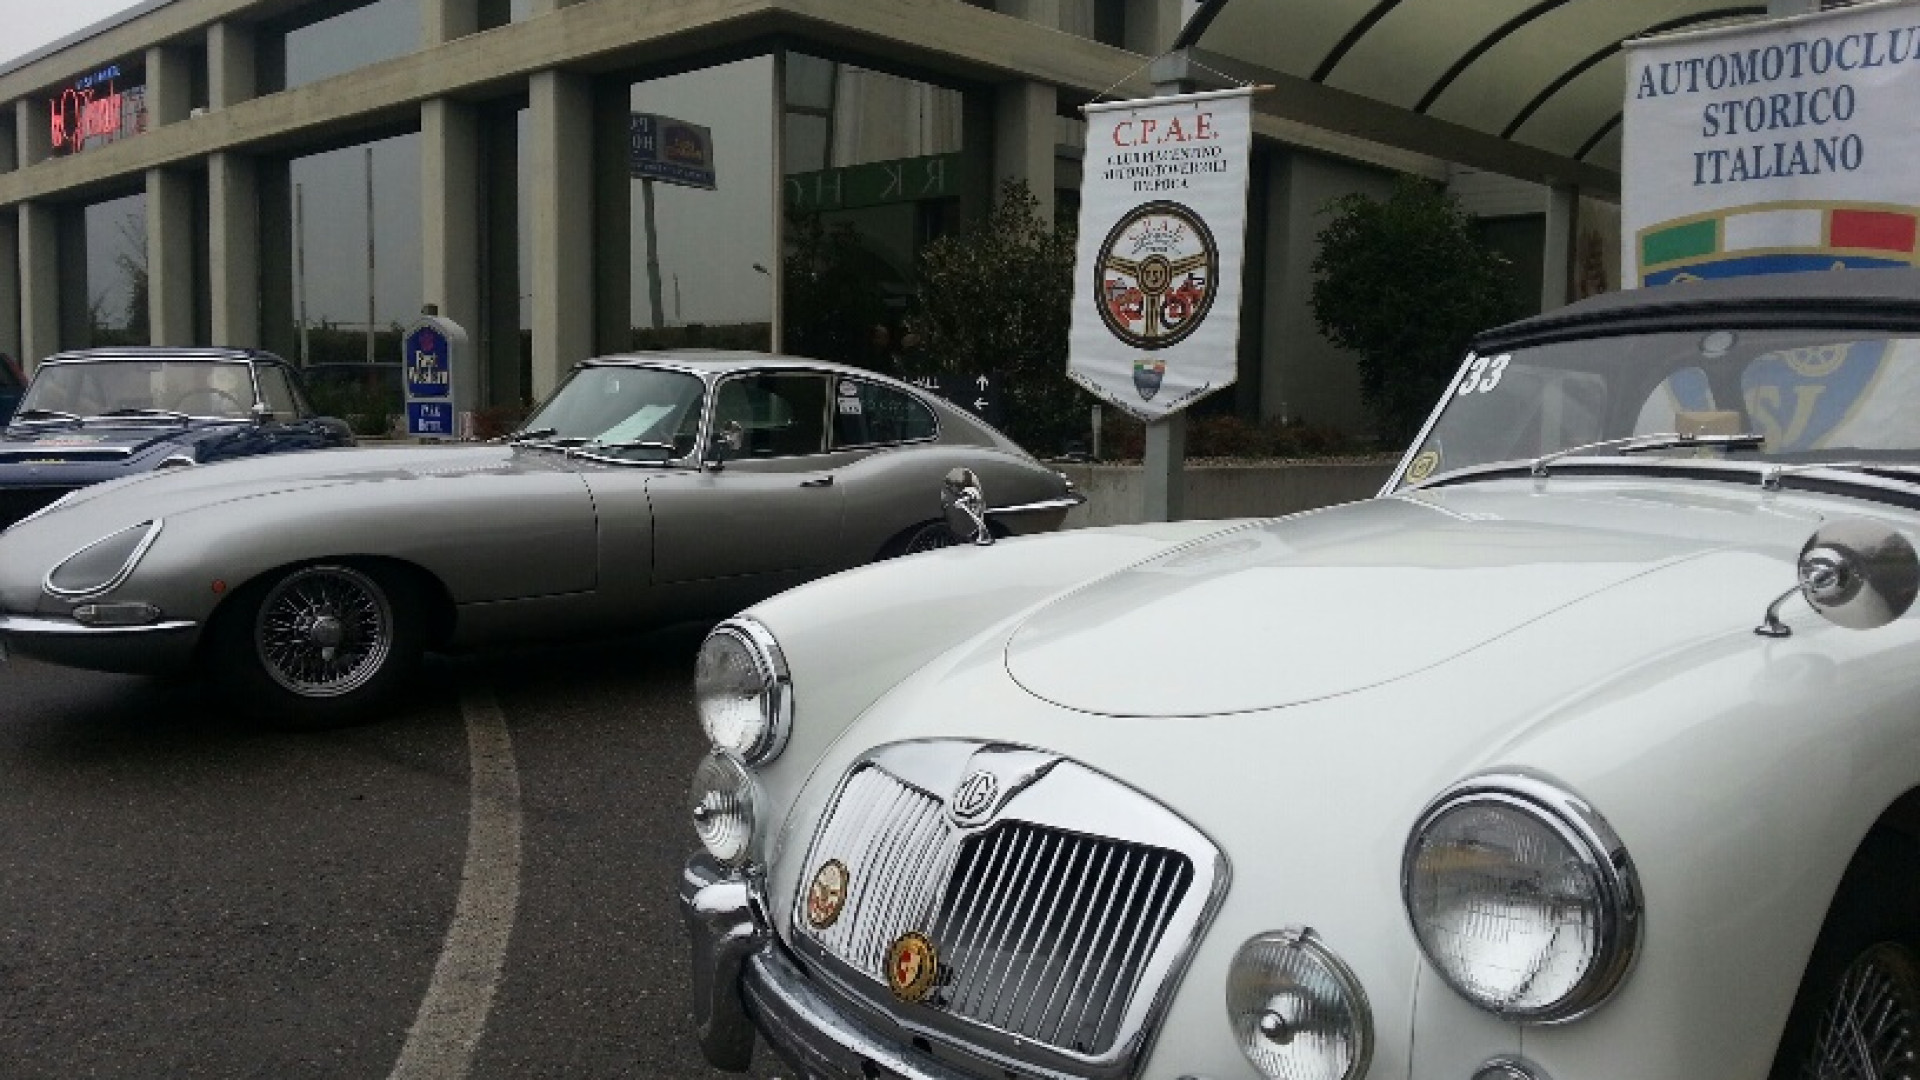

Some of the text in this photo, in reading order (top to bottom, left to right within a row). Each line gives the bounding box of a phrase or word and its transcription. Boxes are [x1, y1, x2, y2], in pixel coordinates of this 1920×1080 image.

[1113, 112, 1219, 147] C.P.A.E.
[1702, 84, 1855, 137] STORICO
[1693, 133, 1864, 186] ITALIANO
[1458, 354, 1512, 396] 33
[957, 773, 994, 812] MG
